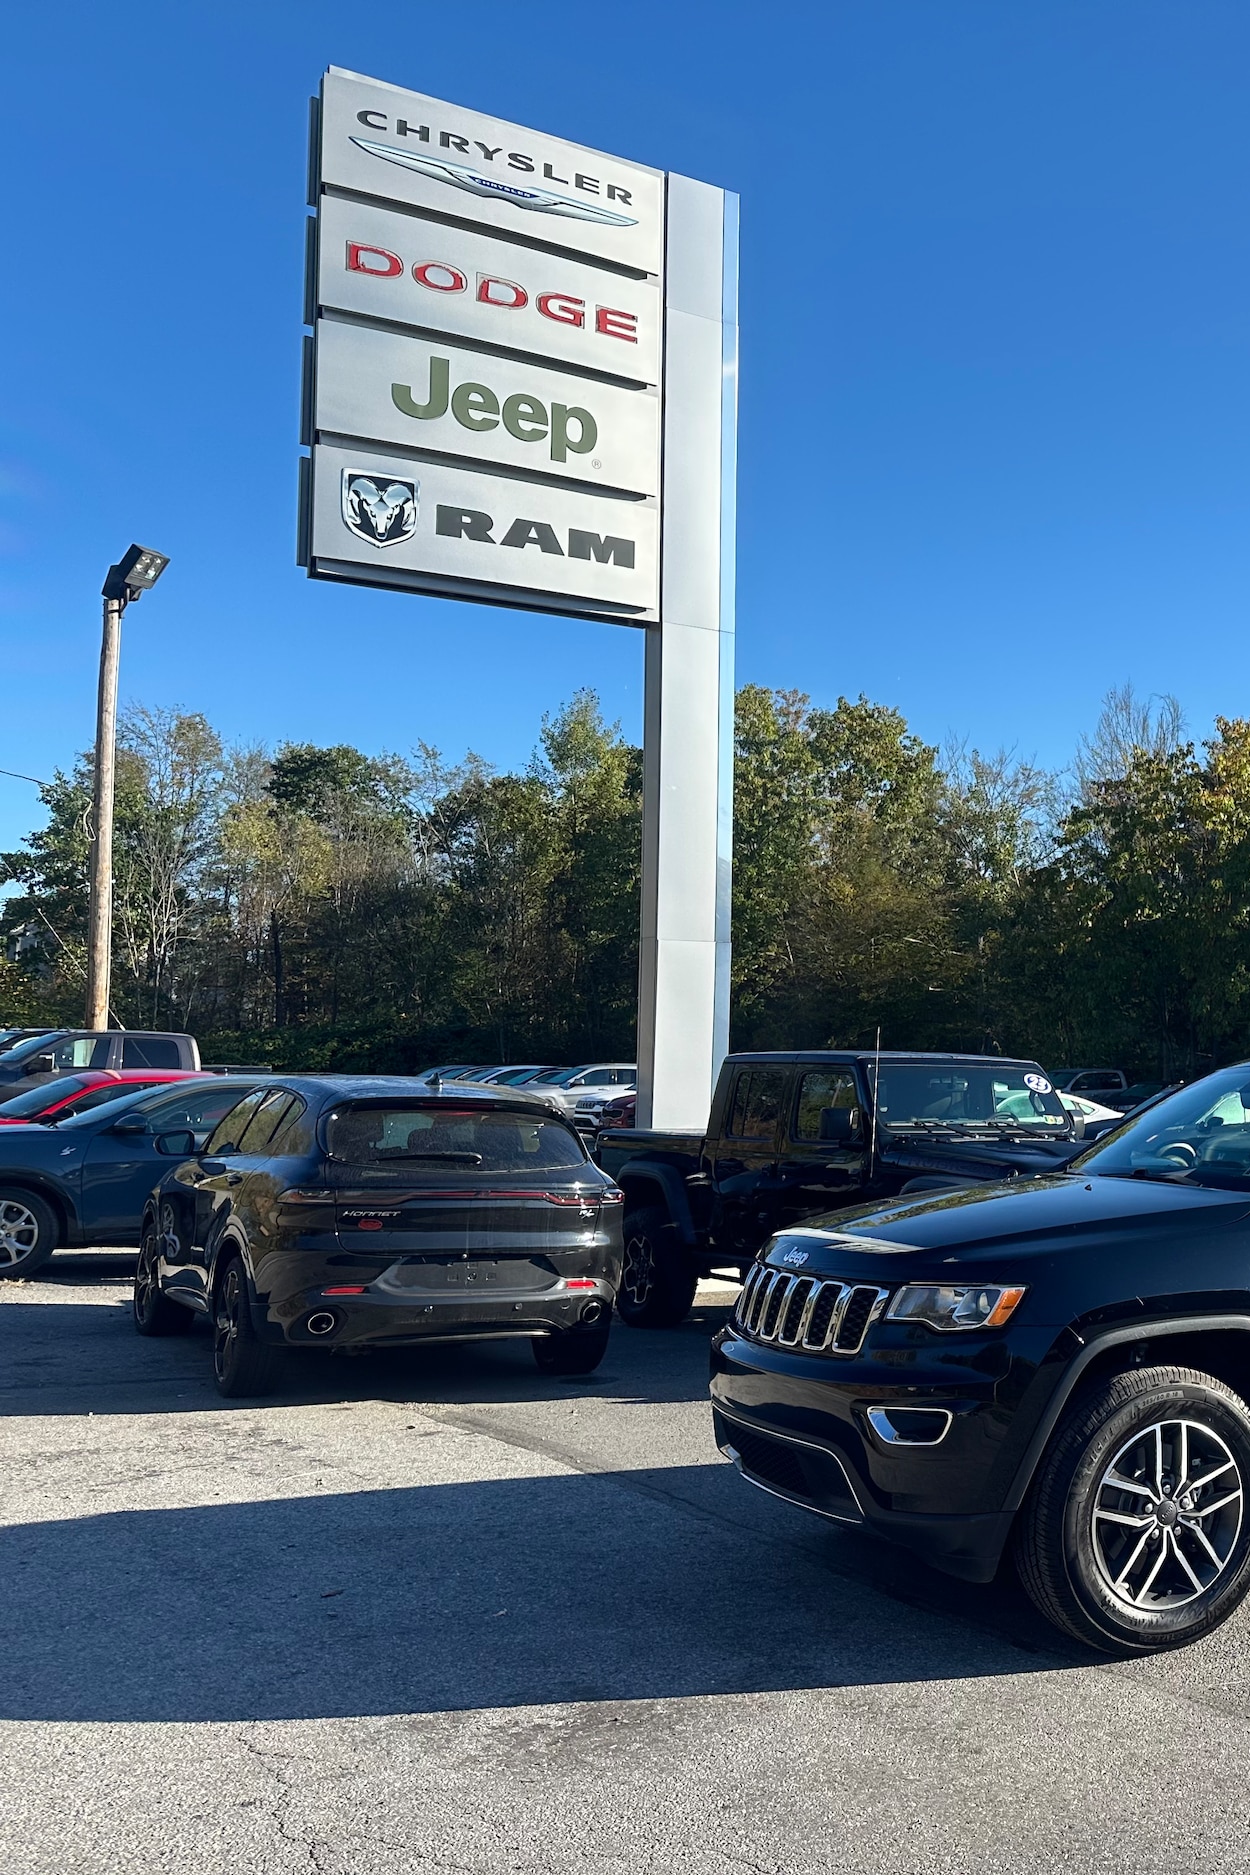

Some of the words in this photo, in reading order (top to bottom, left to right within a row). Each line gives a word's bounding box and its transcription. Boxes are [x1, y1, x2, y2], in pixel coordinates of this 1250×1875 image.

[357, 110, 632, 206] CHRYSLER
[346, 240, 638, 344] DODGE
[391, 356, 598, 462] Jeep
[435, 505, 635, 569] RAM
[783, 1246, 810, 1268] Jeep
